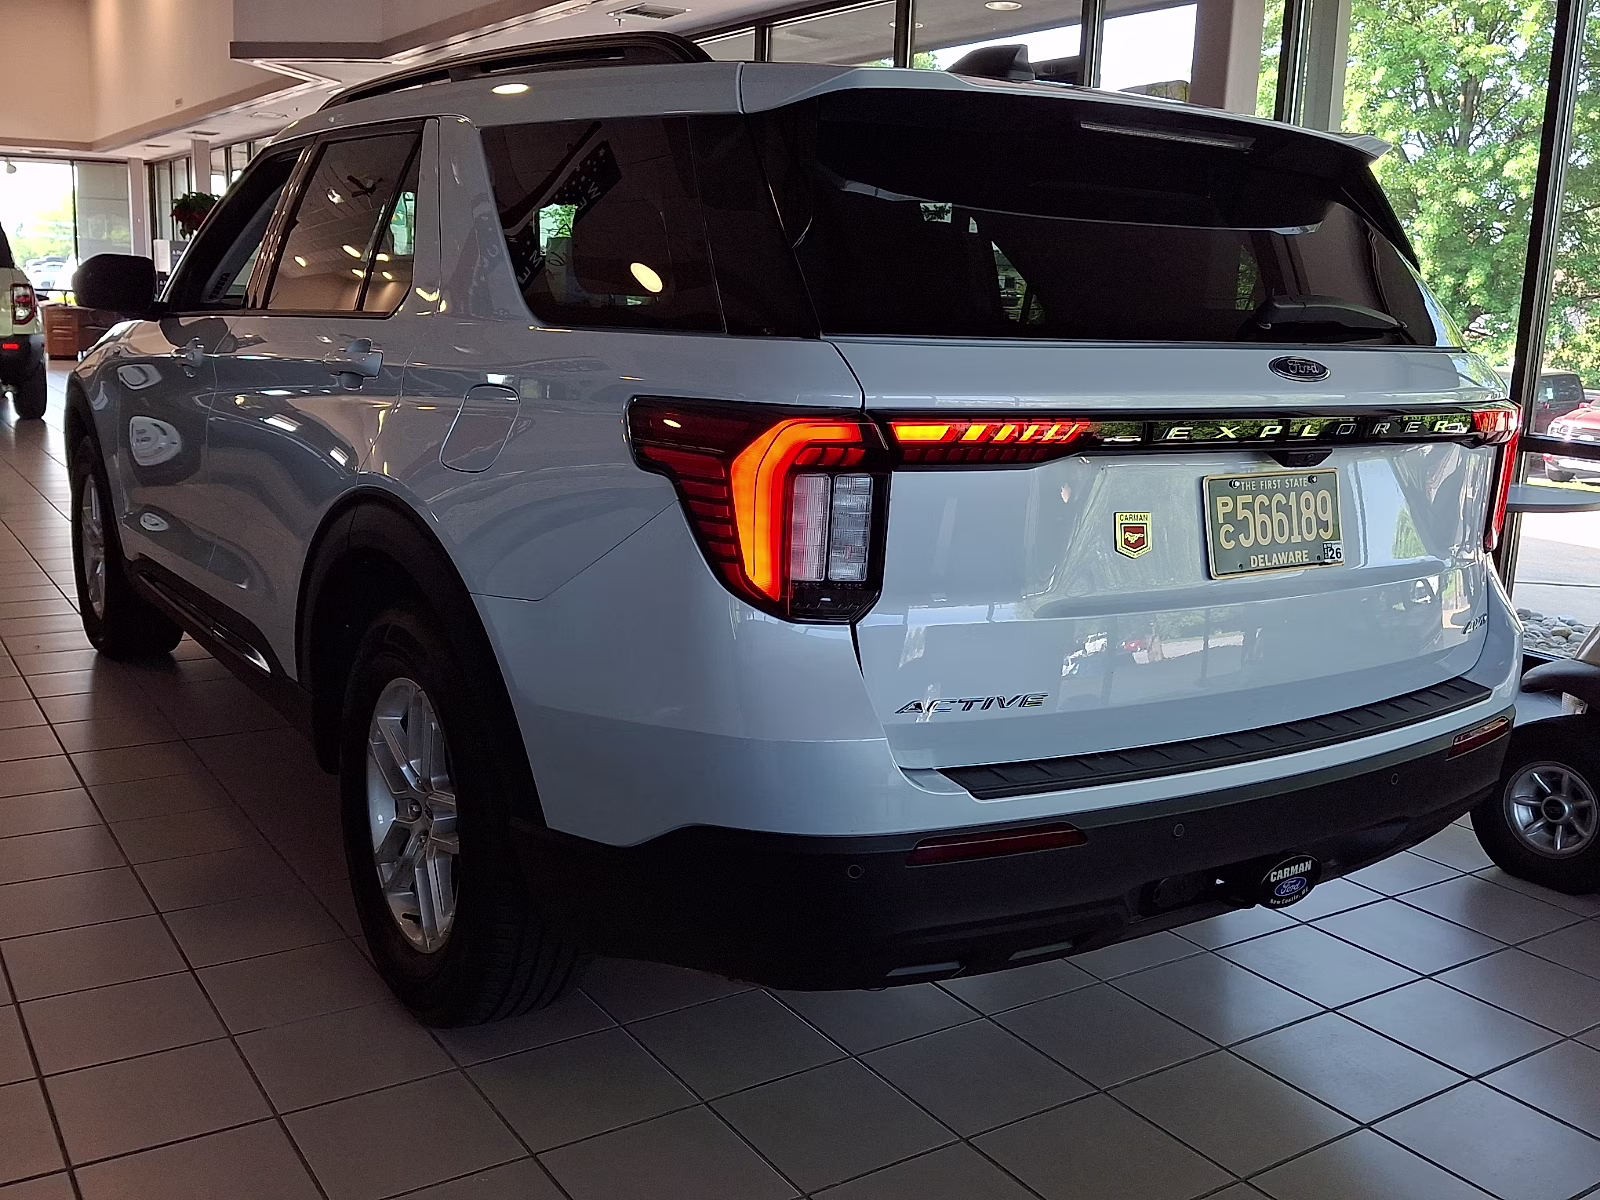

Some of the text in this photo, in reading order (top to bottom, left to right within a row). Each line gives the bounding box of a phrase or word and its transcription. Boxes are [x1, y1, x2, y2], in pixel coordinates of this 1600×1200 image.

[1287, 359, 1320, 374] Ford
[1162, 421, 1452, 440] EXPLORER
[1241, 477, 1308, 491] THE FIRST STATE
[1120, 514, 1148, 522] CARMAN
[1236, 489, 1334, 548] 566189
[1250, 550, 1309, 568] DELAWARE
[1329, 547, 1342, 560] 26
[894, 692, 1049, 715] ACTIVE
[1270, 859, 1312, 883] CARMAN
[1280, 879, 1301, 895] Ford
